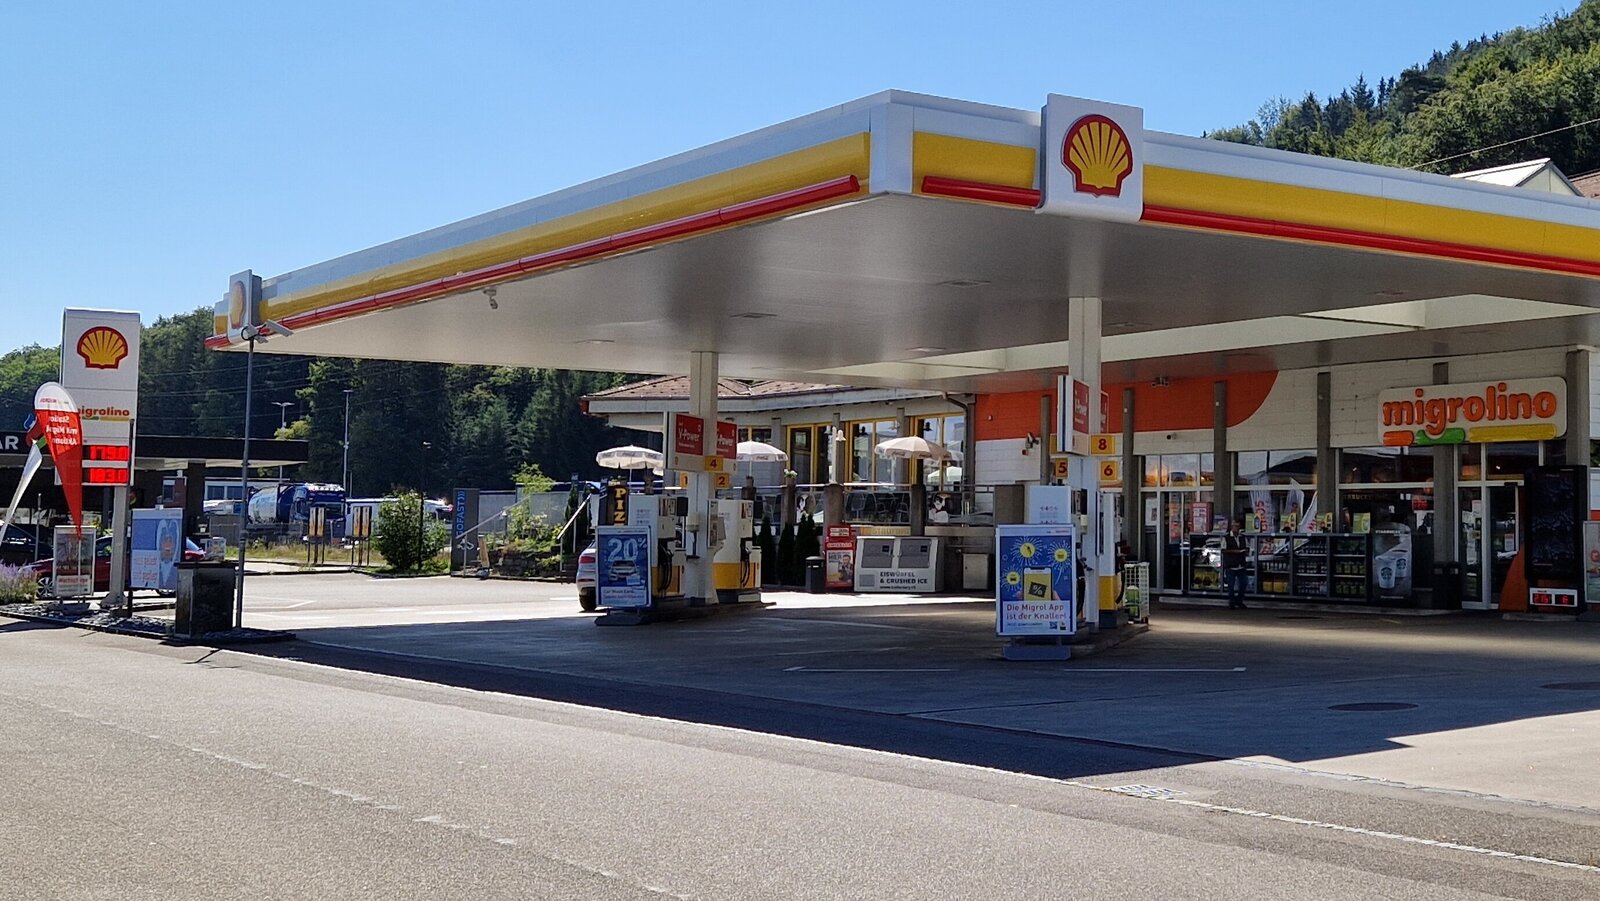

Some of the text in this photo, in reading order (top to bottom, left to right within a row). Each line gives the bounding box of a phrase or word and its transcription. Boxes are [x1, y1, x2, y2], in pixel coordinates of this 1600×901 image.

[78, 406, 130, 418] igrolino
[1382, 382, 1558, 436] migrolino
[678, 428, 700, 442] V-Power
[1098, 438, 1107, 450] 8
[710, 459, 717, 468] 4
[1058, 462, 1068, 474] 5
[1103, 465, 1114, 476] 6
[683, 475, 688, 485] 1
[718, 475, 726, 485] 2
[614, 488, 627, 527] PIZ
[1021, 604, 1047, 612] Migrol
[1049, 604, 1064, 612] App
